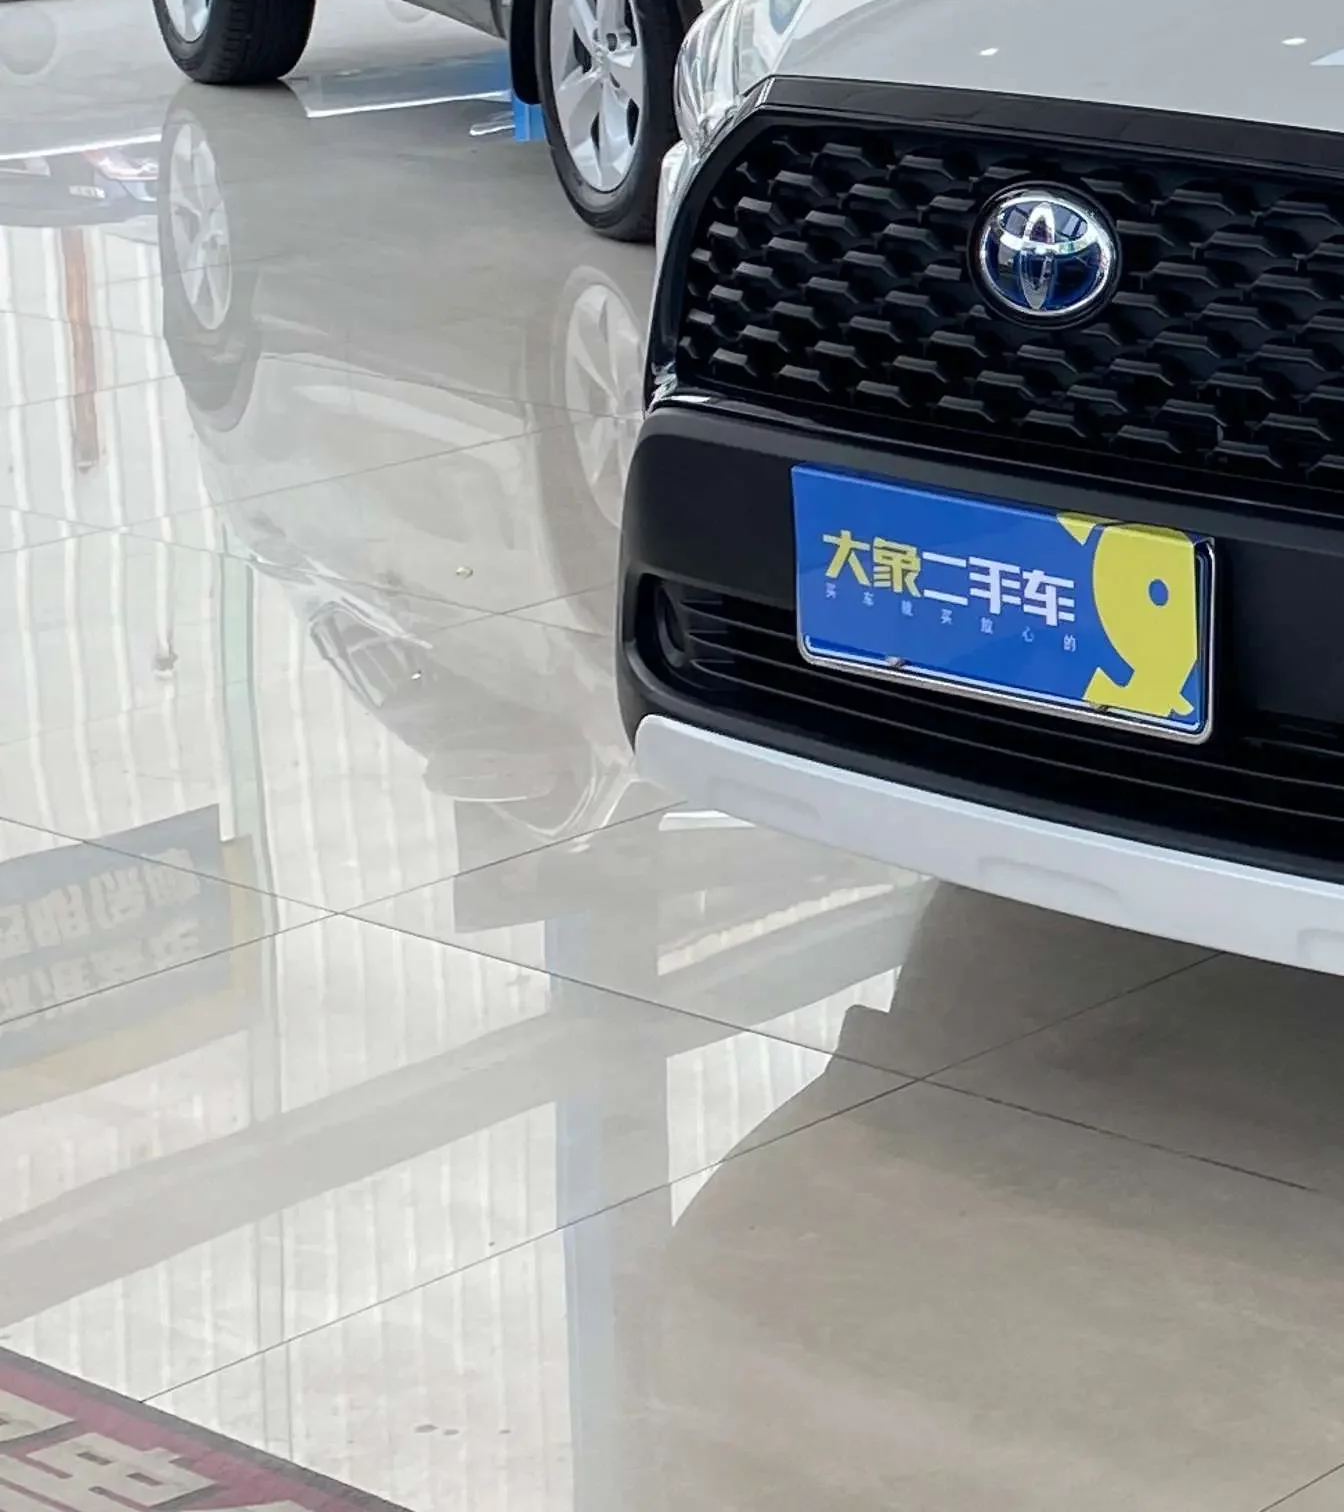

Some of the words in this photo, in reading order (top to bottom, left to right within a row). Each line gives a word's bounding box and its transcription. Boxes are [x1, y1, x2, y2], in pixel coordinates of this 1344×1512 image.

[822, 529, 1076, 627] 大象二手车
